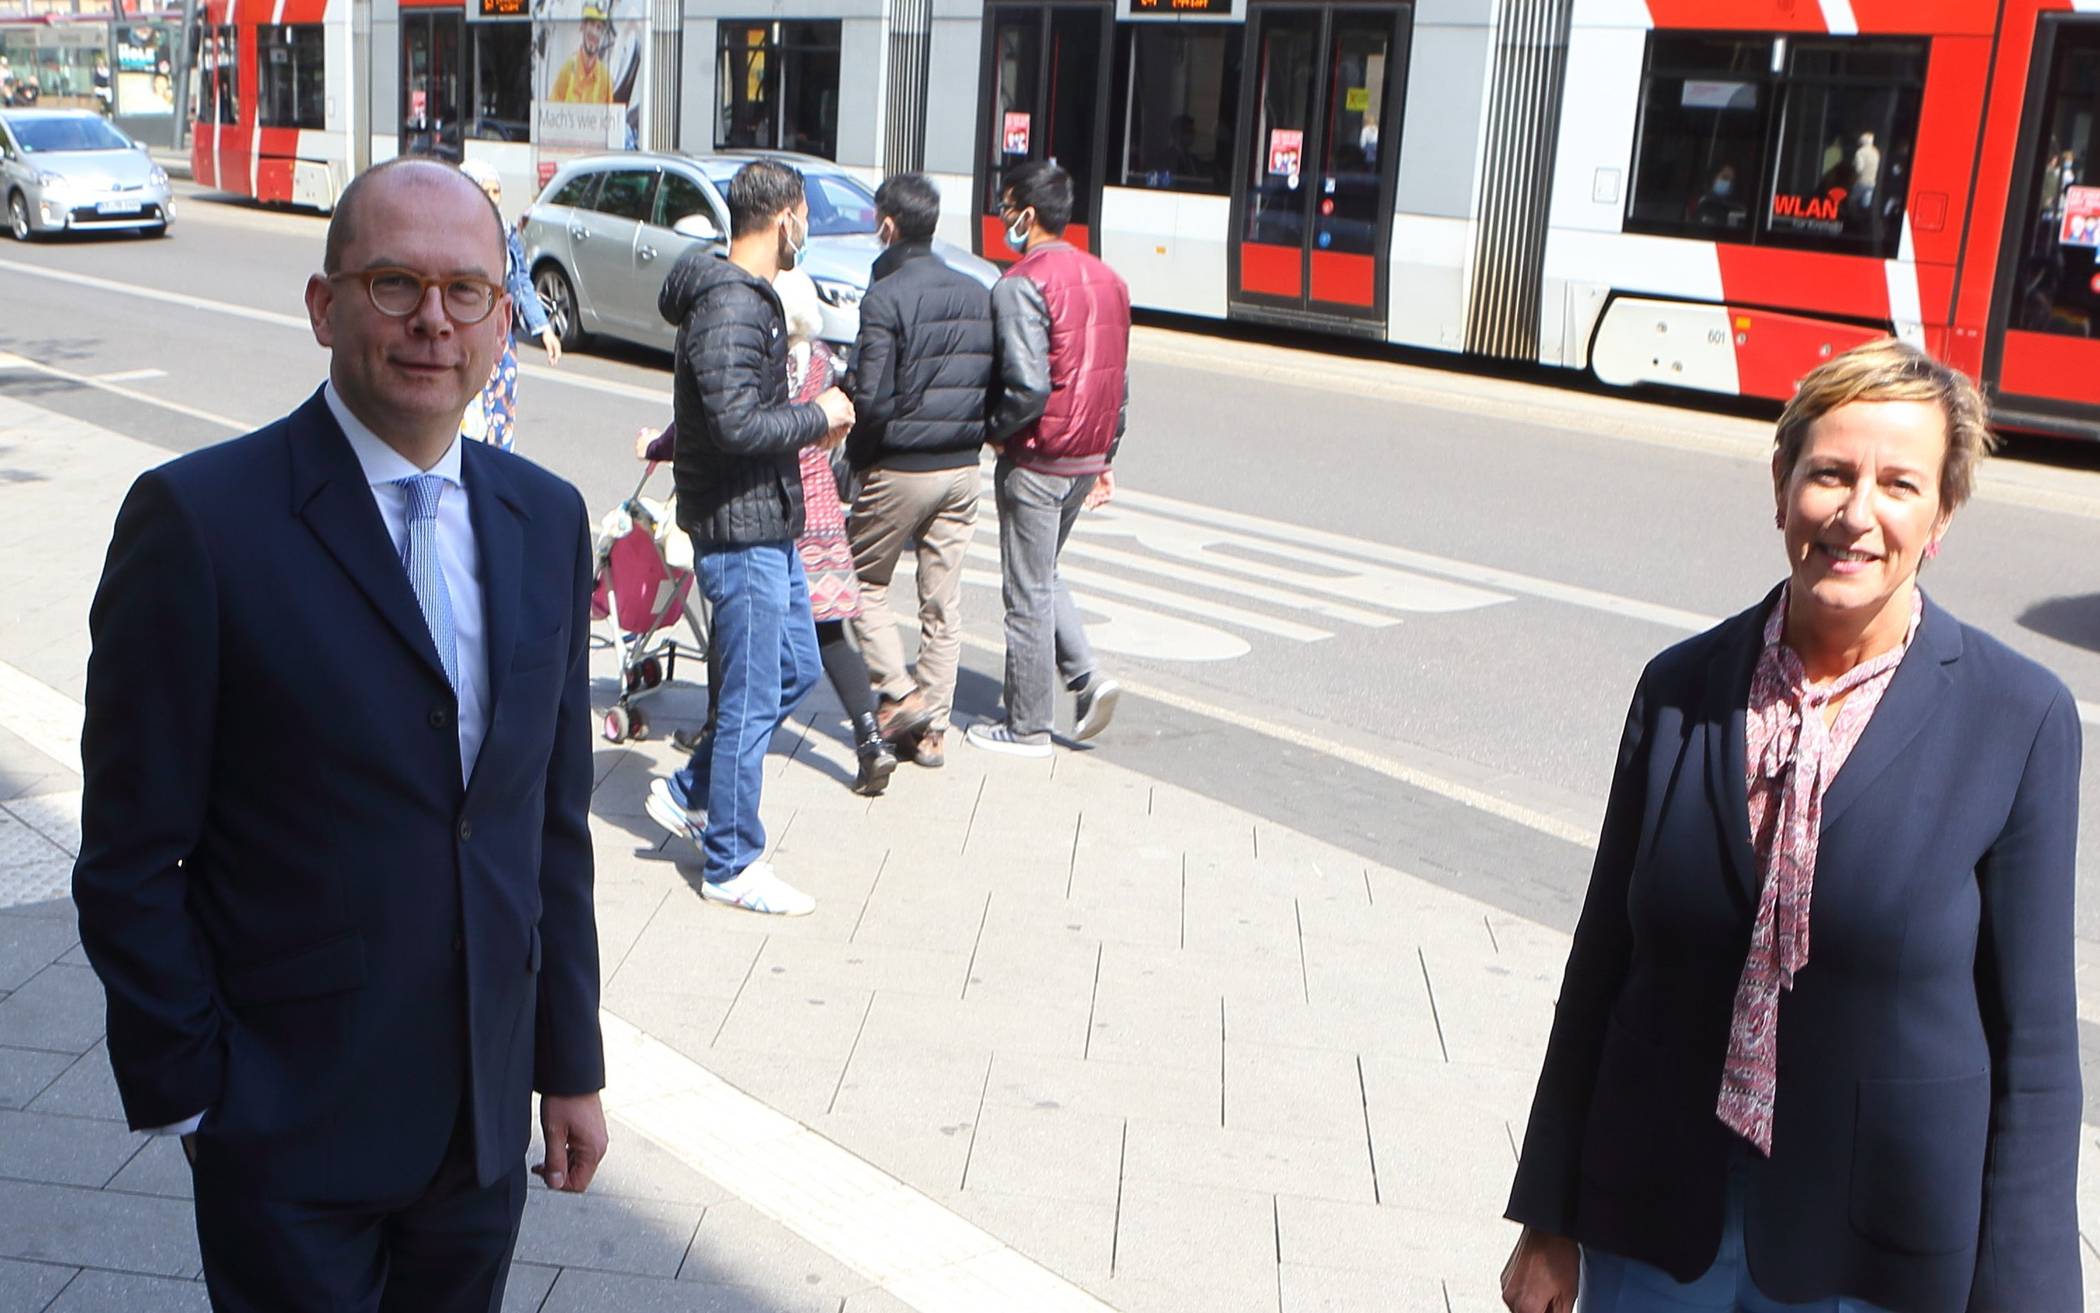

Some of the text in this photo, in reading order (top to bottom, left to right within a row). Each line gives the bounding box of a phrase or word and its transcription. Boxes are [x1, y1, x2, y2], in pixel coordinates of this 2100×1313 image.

[538, 107, 575, 128] Mach's
[577, 110, 597, 130] wie
[1774, 195, 1839, 219] WLAN
[1707, 328, 1726, 344] 601
